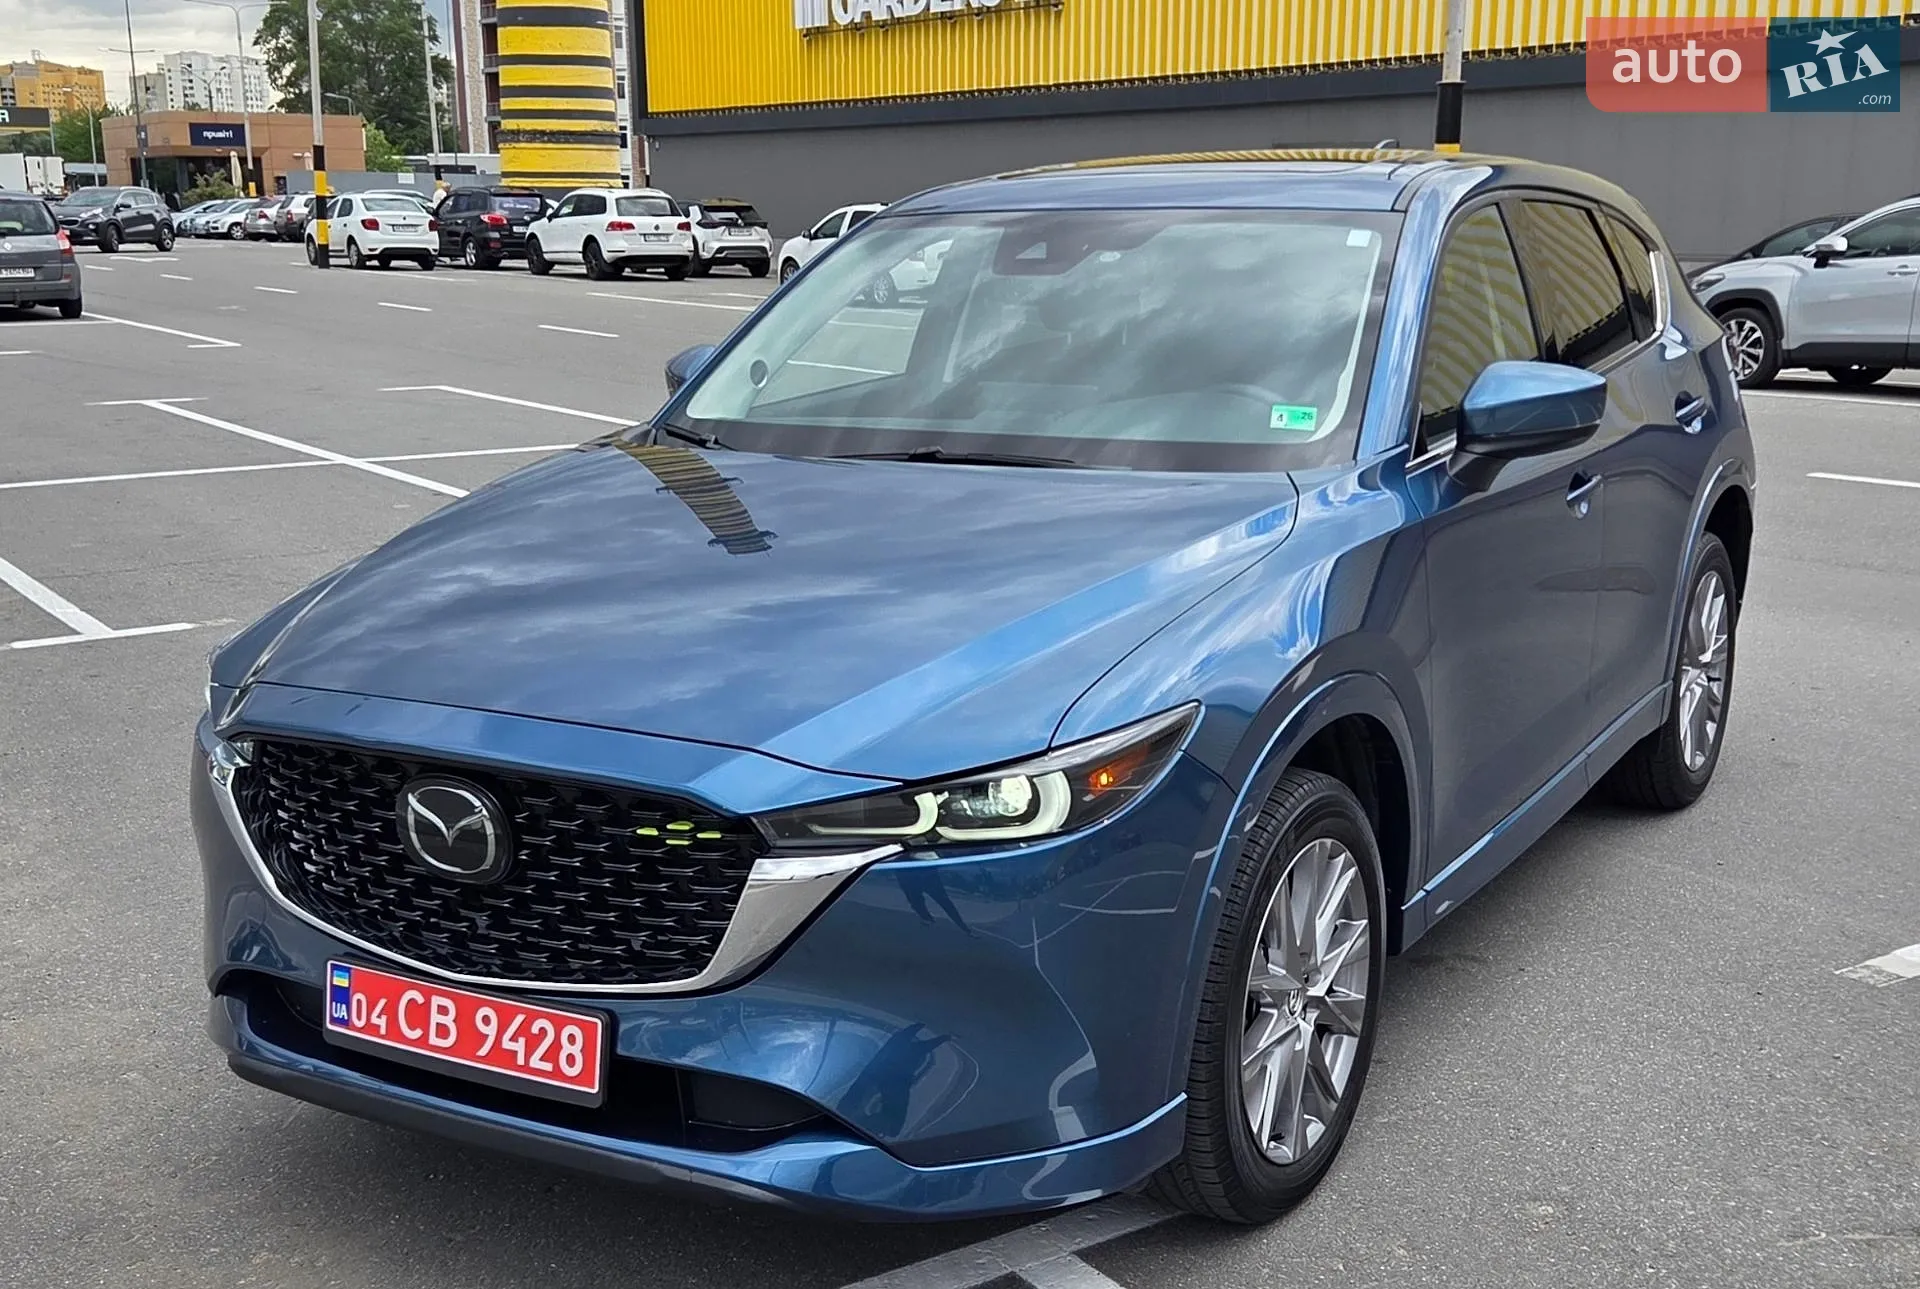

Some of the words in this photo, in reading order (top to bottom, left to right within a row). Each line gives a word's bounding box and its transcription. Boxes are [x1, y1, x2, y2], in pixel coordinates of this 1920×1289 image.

[332, 1001, 348, 1020] UA
[351, 992, 388, 1036] 04
[398, 989, 458, 1049] CB
[475, 1006, 584, 1078] 9428
